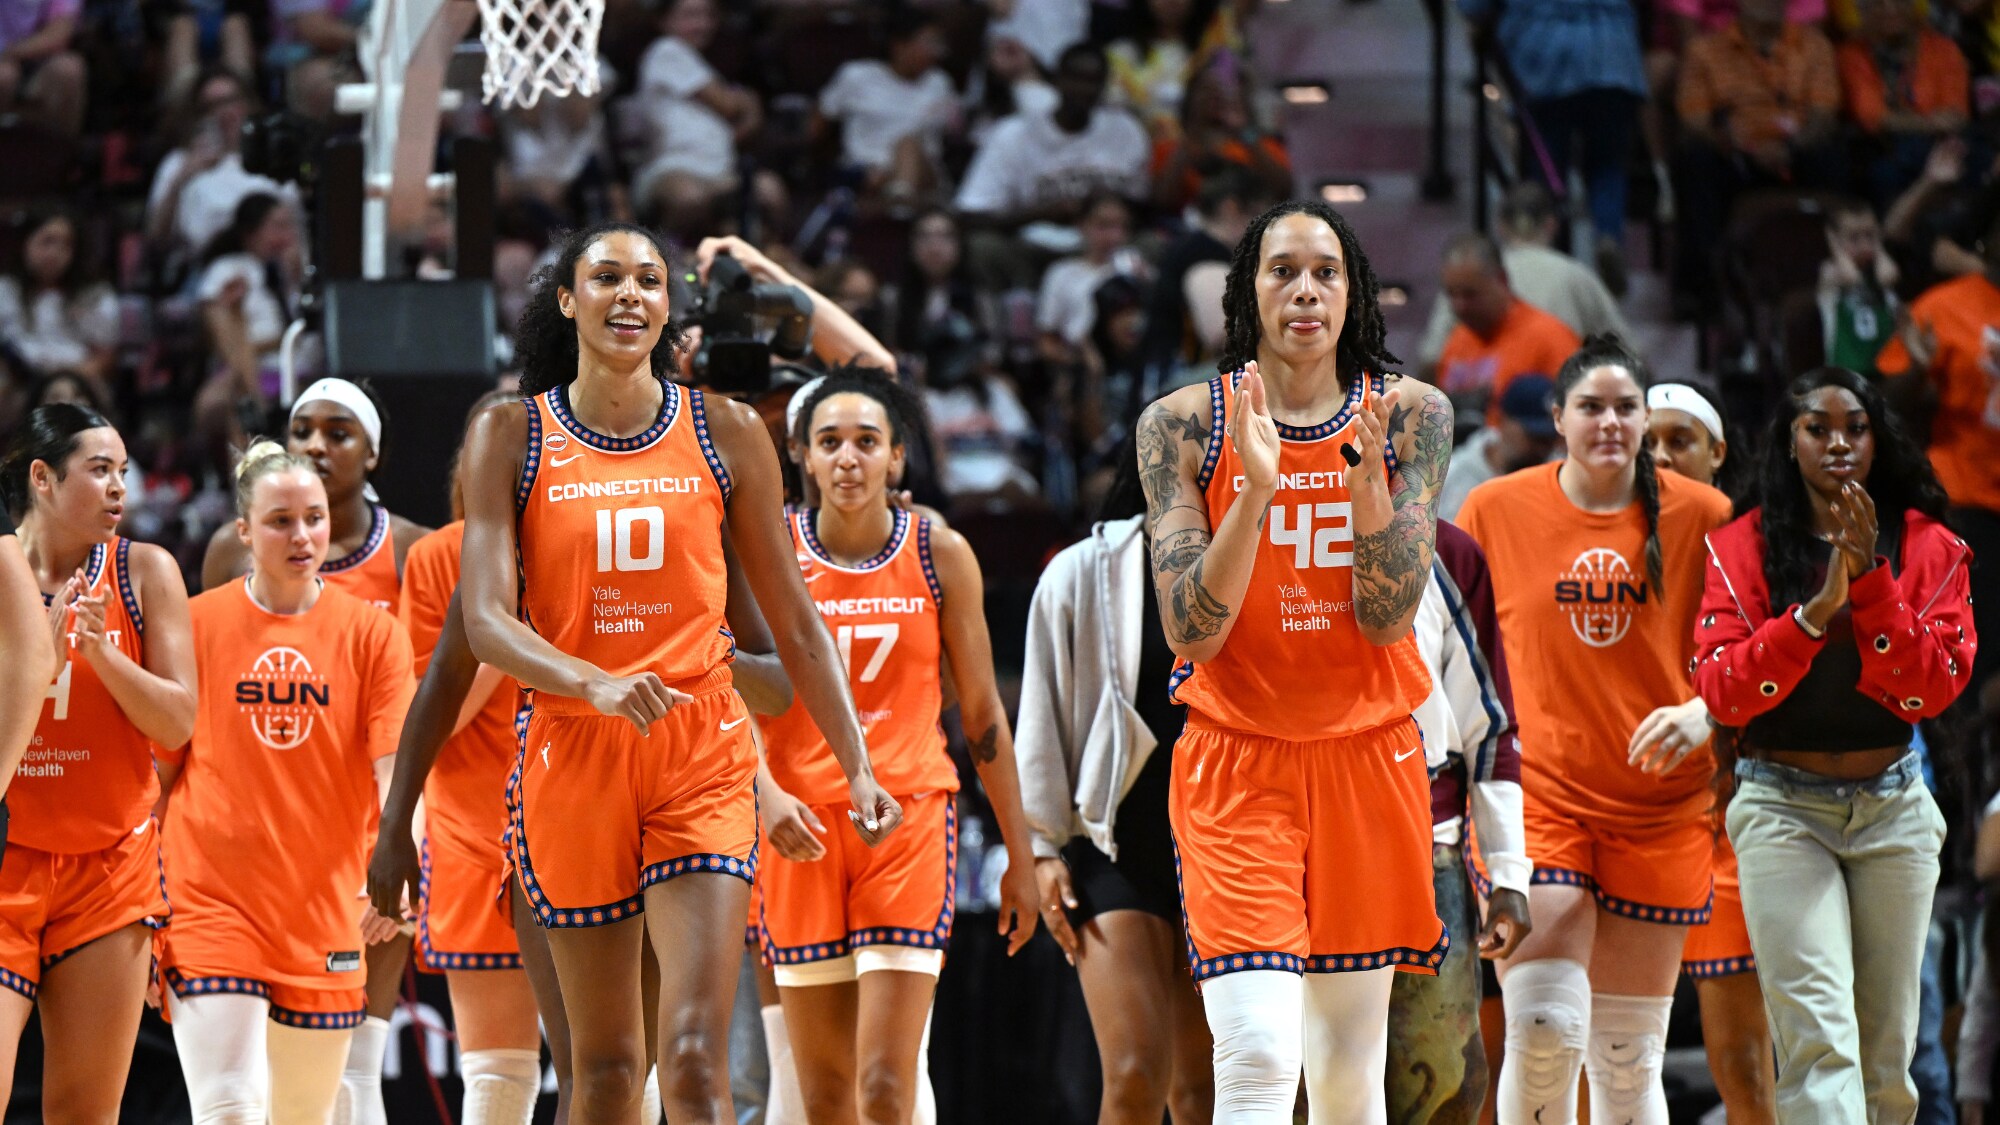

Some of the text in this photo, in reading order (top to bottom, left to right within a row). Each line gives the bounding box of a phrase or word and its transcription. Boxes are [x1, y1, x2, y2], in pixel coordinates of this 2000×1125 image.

[548, 477, 702, 502] CONNECTICUT
[596, 506, 664, 572] 10
[1269, 502, 1354, 569] 42
[592, 586, 621, 600] Yale
[1278, 584, 1307, 599] Yale
[1555, 581, 1647, 604] SUN
[593, 602, 672, 617] NewHaven
[594, 618, 645, 634] Health
[1282, 616, 1331, 632] Health
[236, 681, 329, 706] SUN
[18, 763, 64, 778] Health
